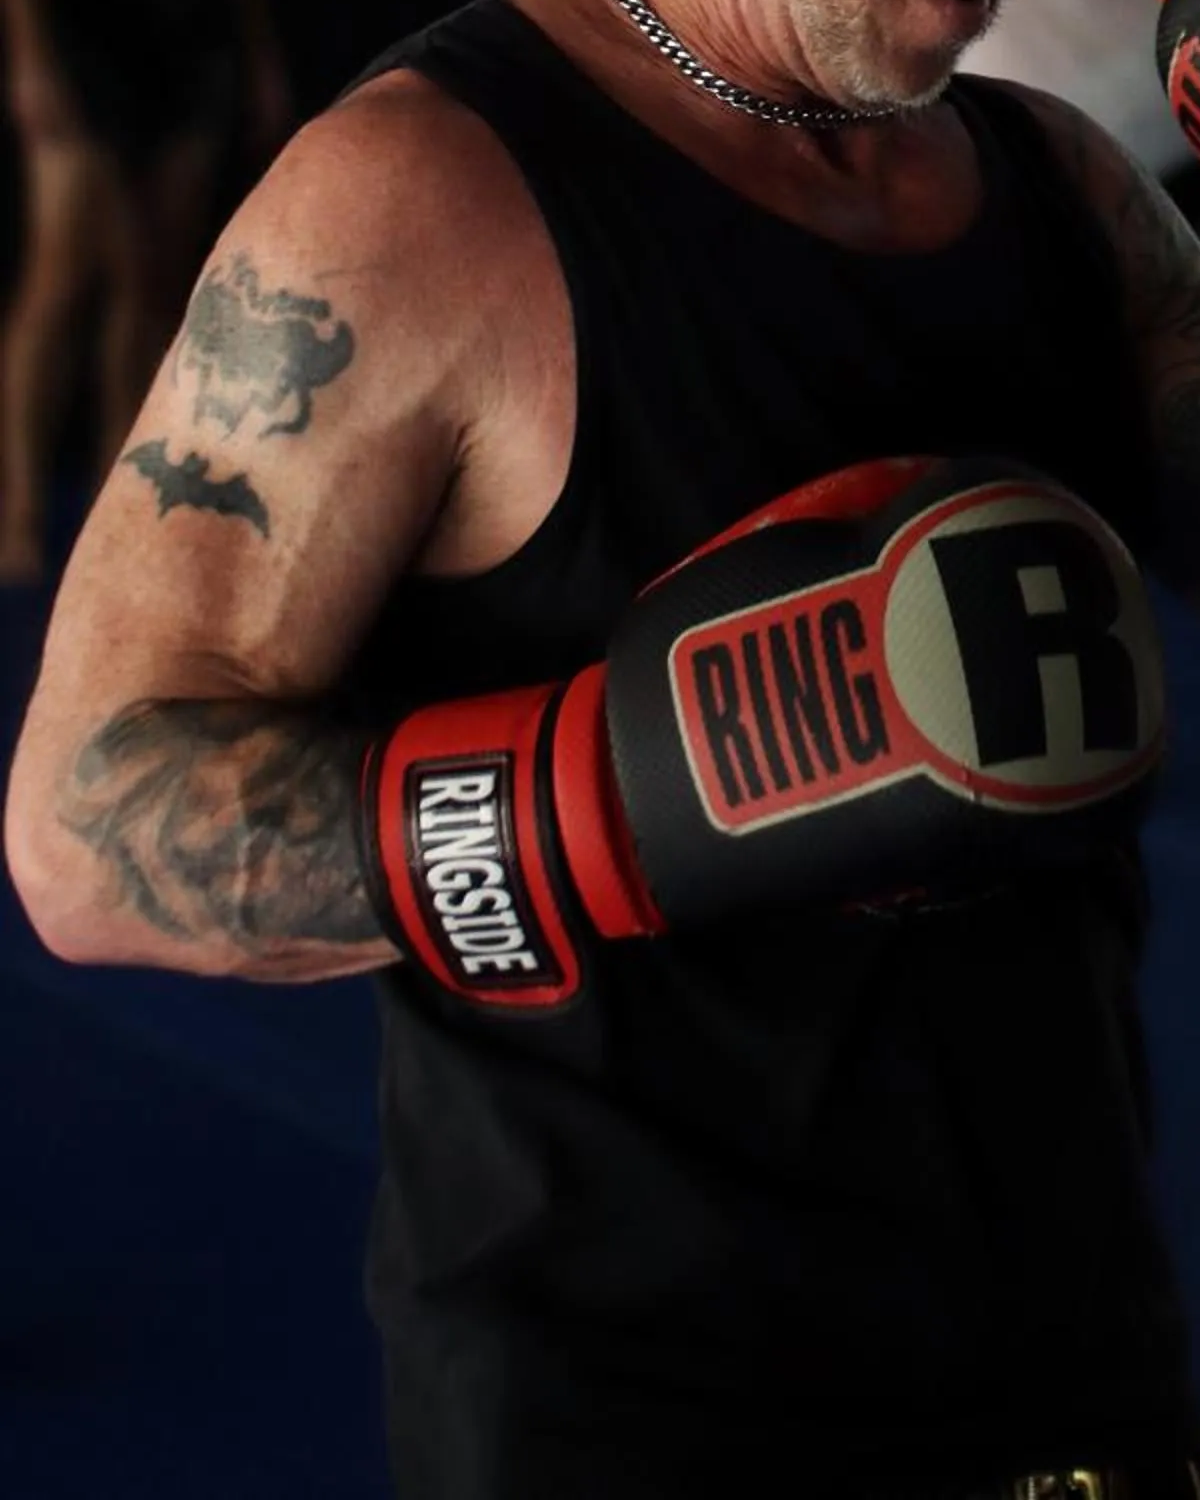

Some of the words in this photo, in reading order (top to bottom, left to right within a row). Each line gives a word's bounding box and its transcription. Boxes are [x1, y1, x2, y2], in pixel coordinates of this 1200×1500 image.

[691, 600, 891, 809] RING
[928, 520, 1140, 768] R
[419, 770, 539, 975] RINGSIDE
